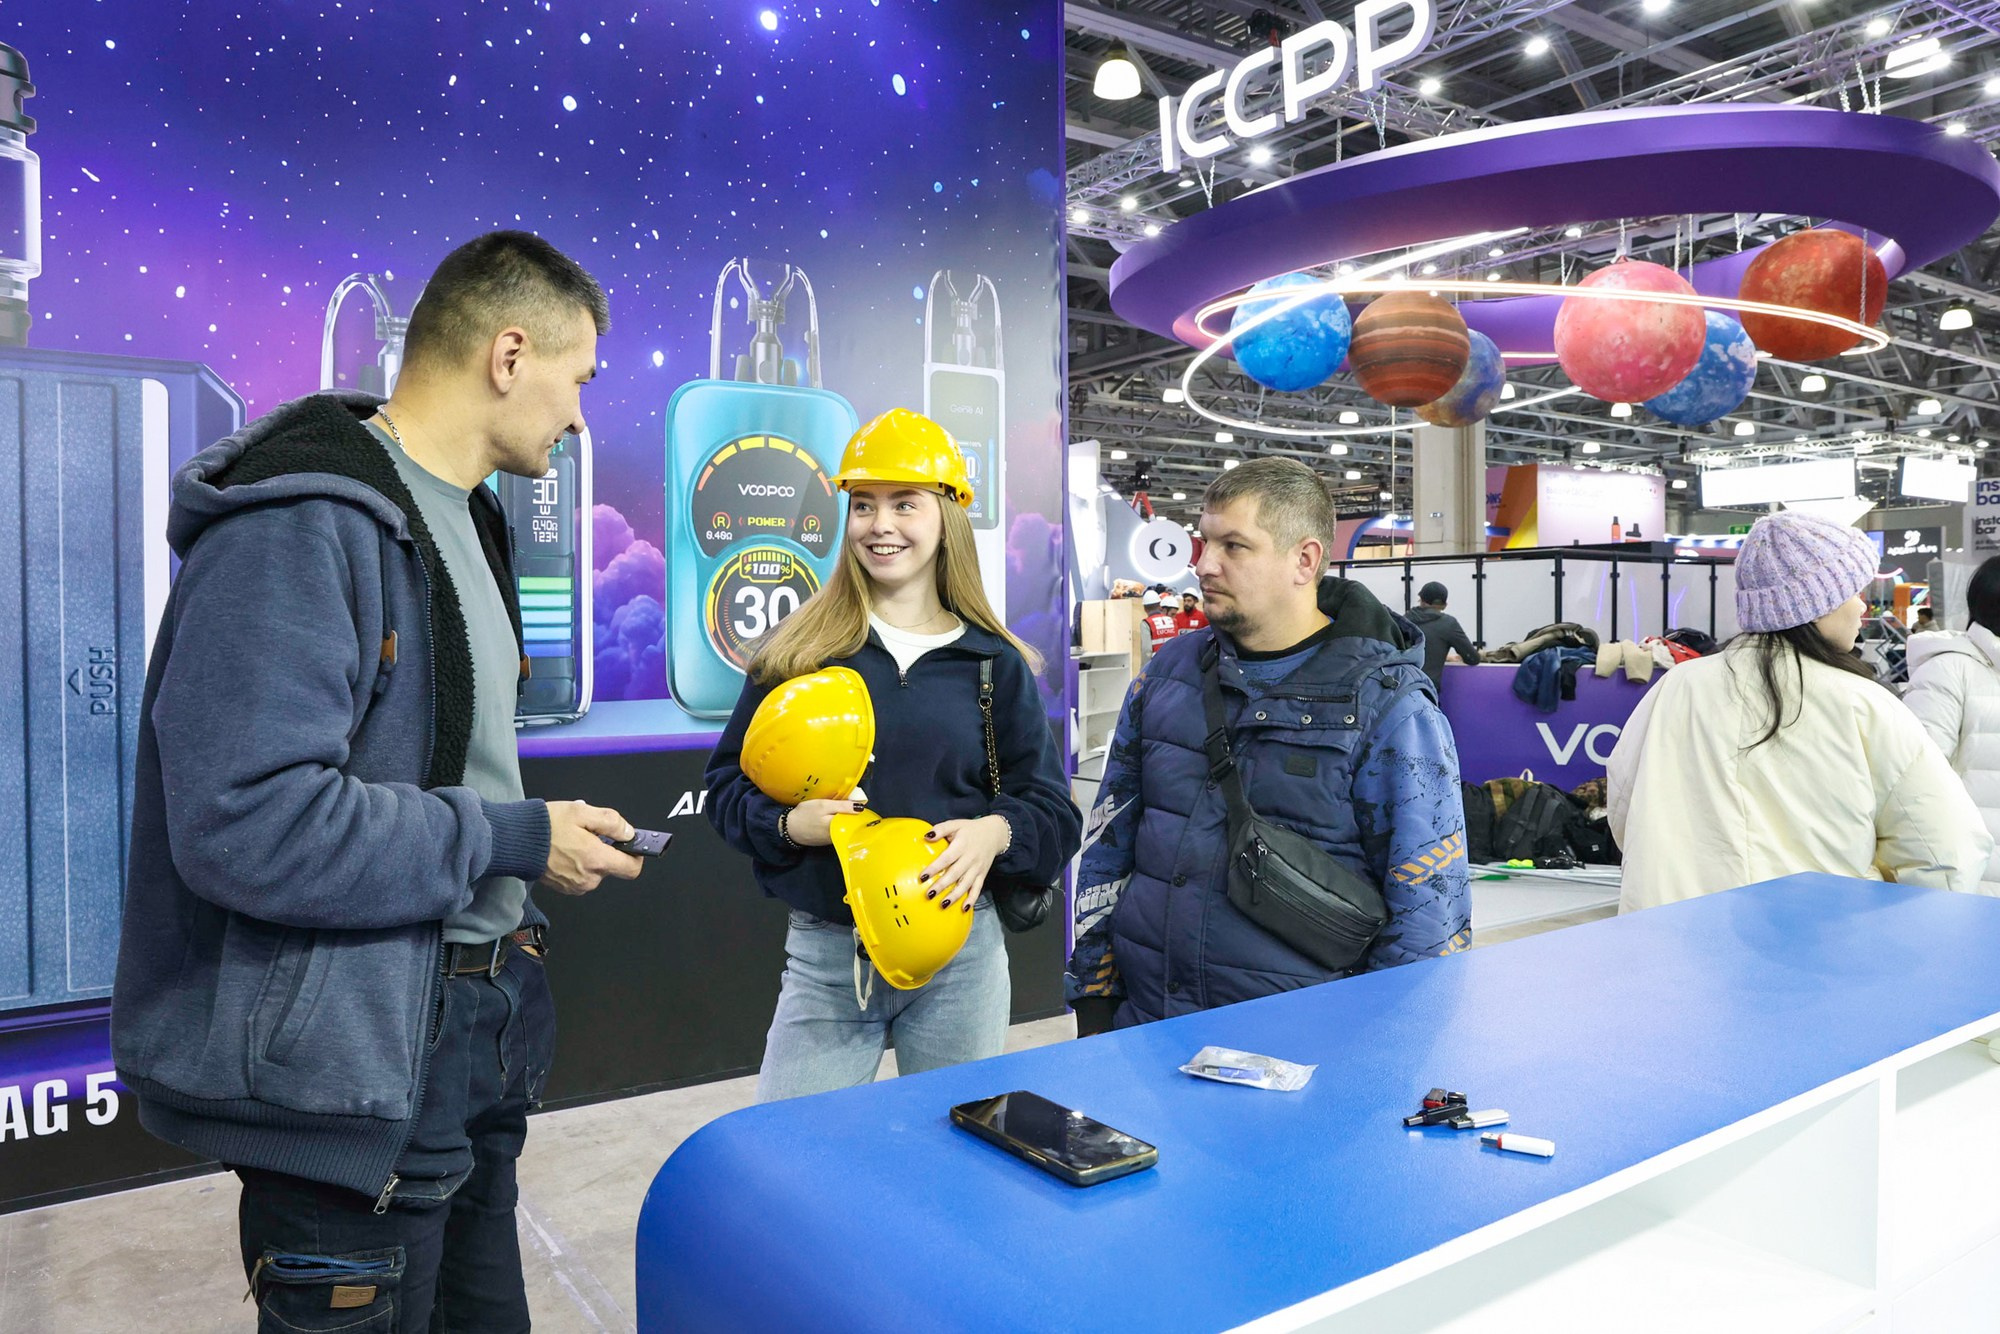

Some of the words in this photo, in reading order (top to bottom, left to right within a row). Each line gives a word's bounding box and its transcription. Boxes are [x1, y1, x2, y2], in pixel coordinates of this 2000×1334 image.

[1158, 0, 1438, 174] ICCPP
[532, 479, 558, 505] 30
[738, 483, 796, 498] VOOPOO
[540, 505, 551, 516] W
[747, 516, 786, 528] POWER
[533, 531, 558, 543] 1234
[752, 563, 791, 575] 100%
[733, 585, 801, 640] 30
[88, 646, 116, 716] PUSH
[85, 1070, 120, 1126] 5
